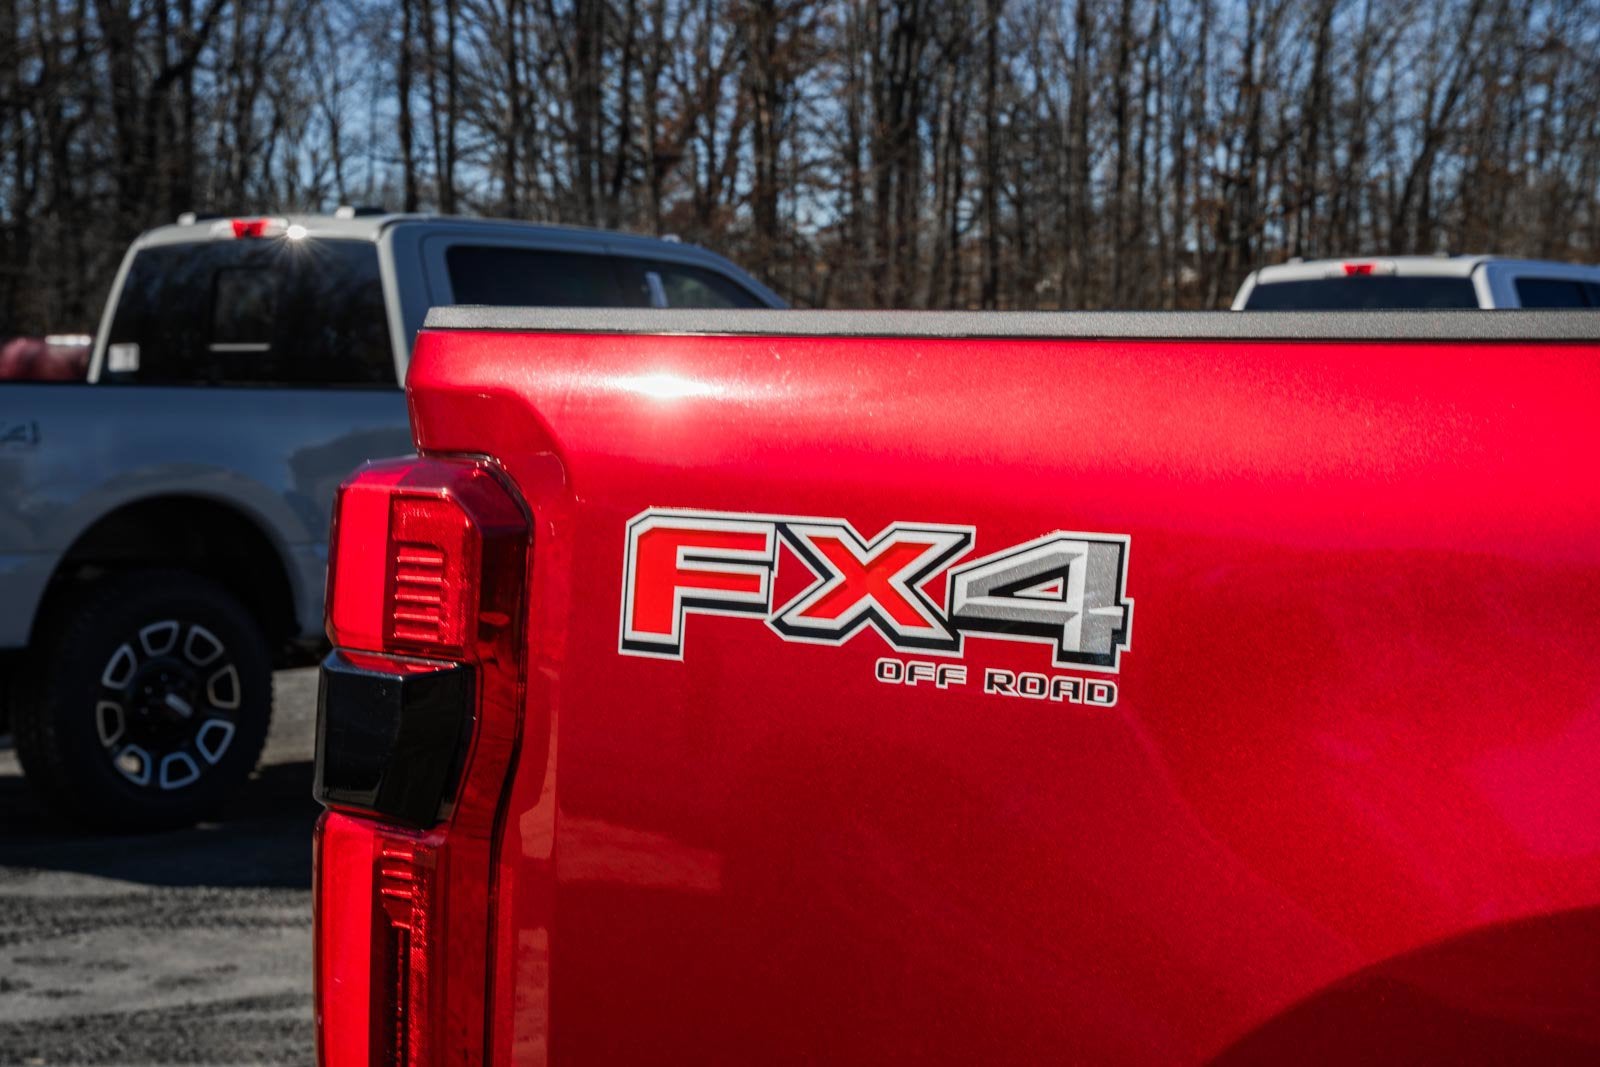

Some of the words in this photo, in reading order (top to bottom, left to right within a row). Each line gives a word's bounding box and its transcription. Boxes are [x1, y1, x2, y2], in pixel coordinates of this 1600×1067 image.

[618, 507, 1134, 673] FX4
[875, 657, 967, 689] OFF
[984, 668, 1118, 707] ROAD
